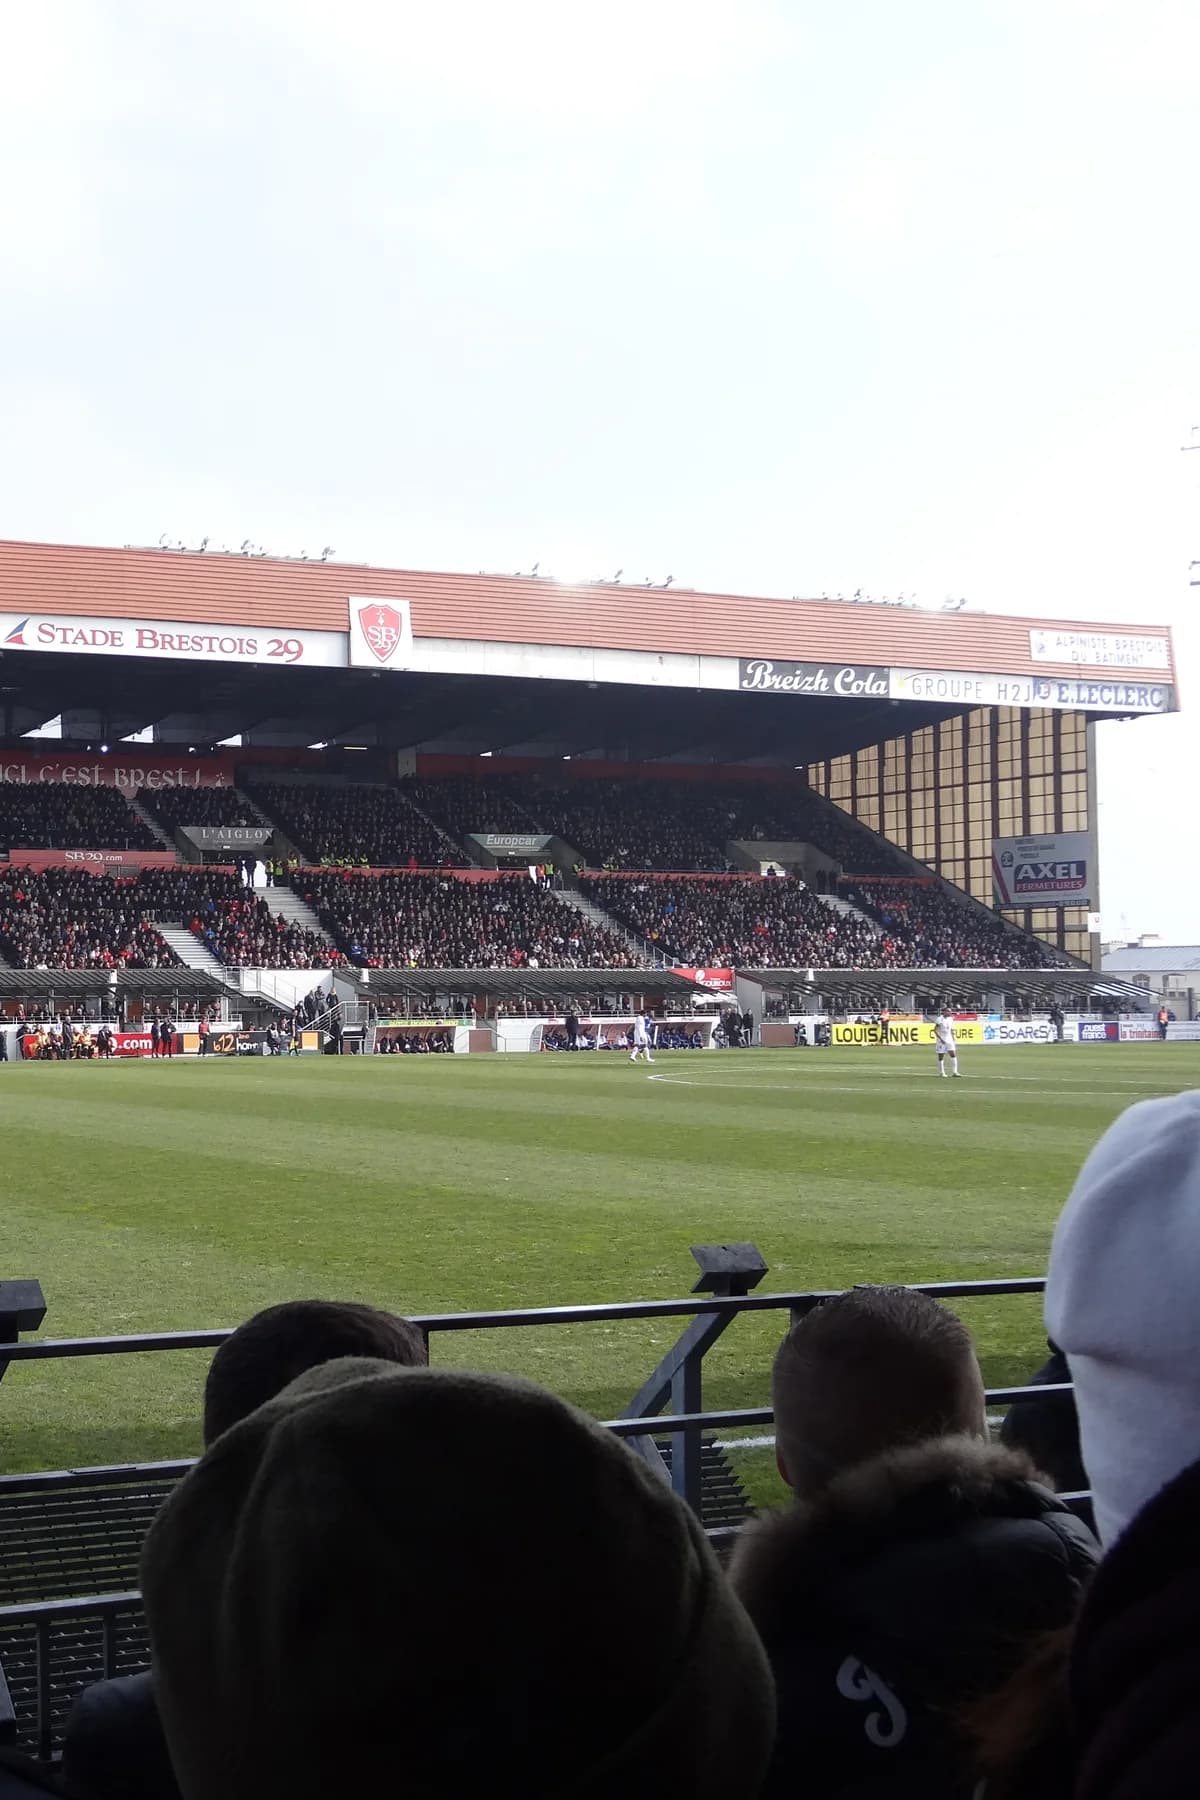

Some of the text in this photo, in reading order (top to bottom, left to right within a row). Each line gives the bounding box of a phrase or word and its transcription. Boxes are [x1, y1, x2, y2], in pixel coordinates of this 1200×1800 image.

[367, 625, 397, 641] SB
[267, 638, 304, 662] 29
[741, 660, 888, 695] Breizh Cola
[912, 677, 983, 699] GROUPE
[1057, 682, 1163, 708] E.LECLERC
[486, 834, 537, 848] Europcar
[1017, 862, 1083, 880] AXEL
[1016, 880, 1083, 891] FERMETURES
